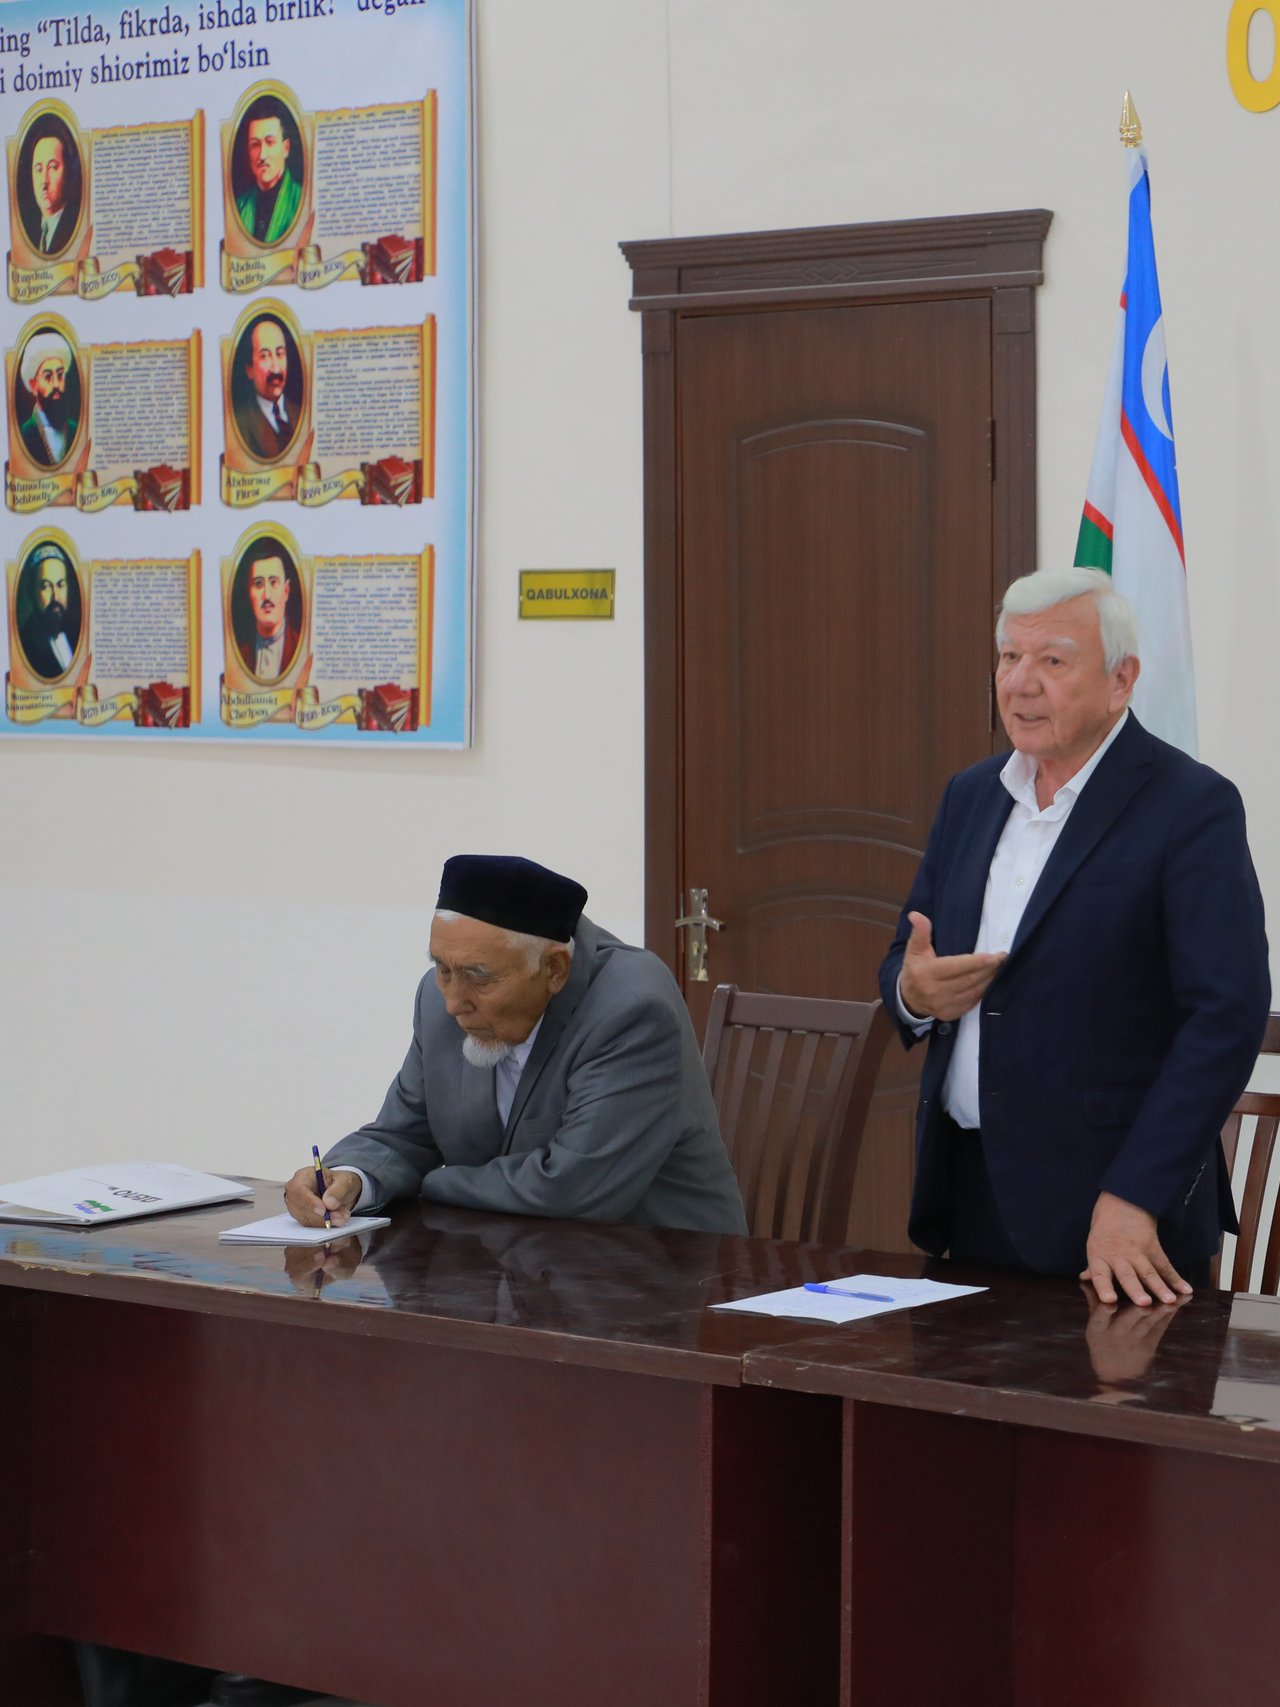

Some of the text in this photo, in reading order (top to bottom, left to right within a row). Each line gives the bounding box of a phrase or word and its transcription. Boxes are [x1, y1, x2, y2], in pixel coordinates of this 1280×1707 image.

[119, 5, 190, 37] fikrda,
[199, 0, 257, 31] ishda
[13, 64, 83, 93] doimiy
[90, 49, 190, 84] shiorimiz
[526, 588, 608, 600] QABULXONA
